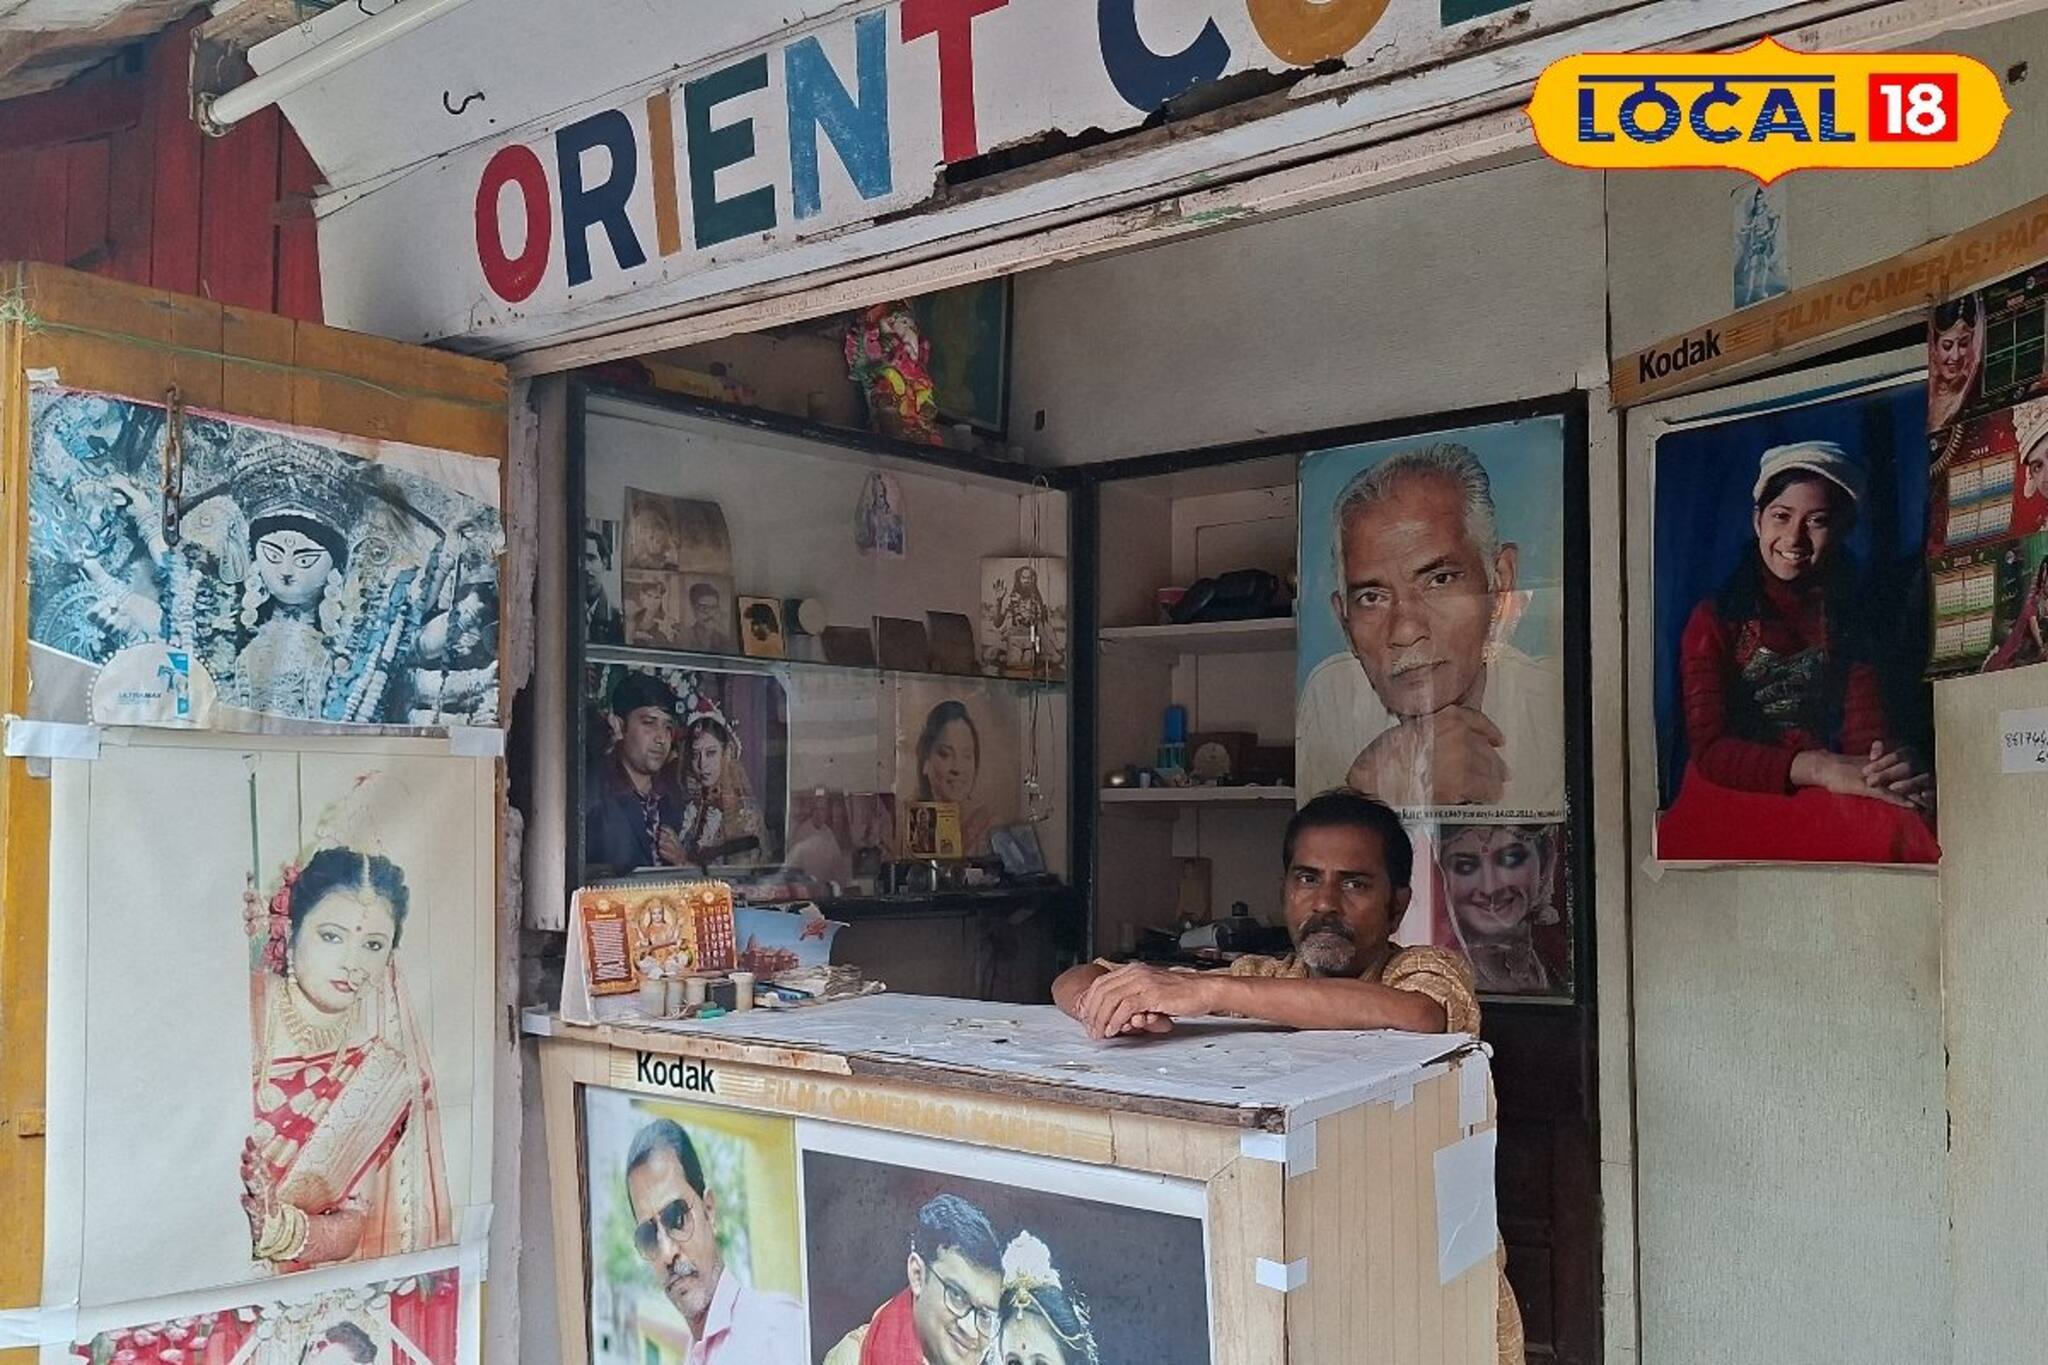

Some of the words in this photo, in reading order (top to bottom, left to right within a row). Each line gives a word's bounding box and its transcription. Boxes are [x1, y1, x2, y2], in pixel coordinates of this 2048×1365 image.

[475, 0, 1009, 304] ORIENT
[1638, 328, 1723, 384] Kodak
[1771, 294, 1833, 345] FILM
[1845, 240, 1985, 315] CAMERAS
[637, 1051, 716, 1093] Kodak
